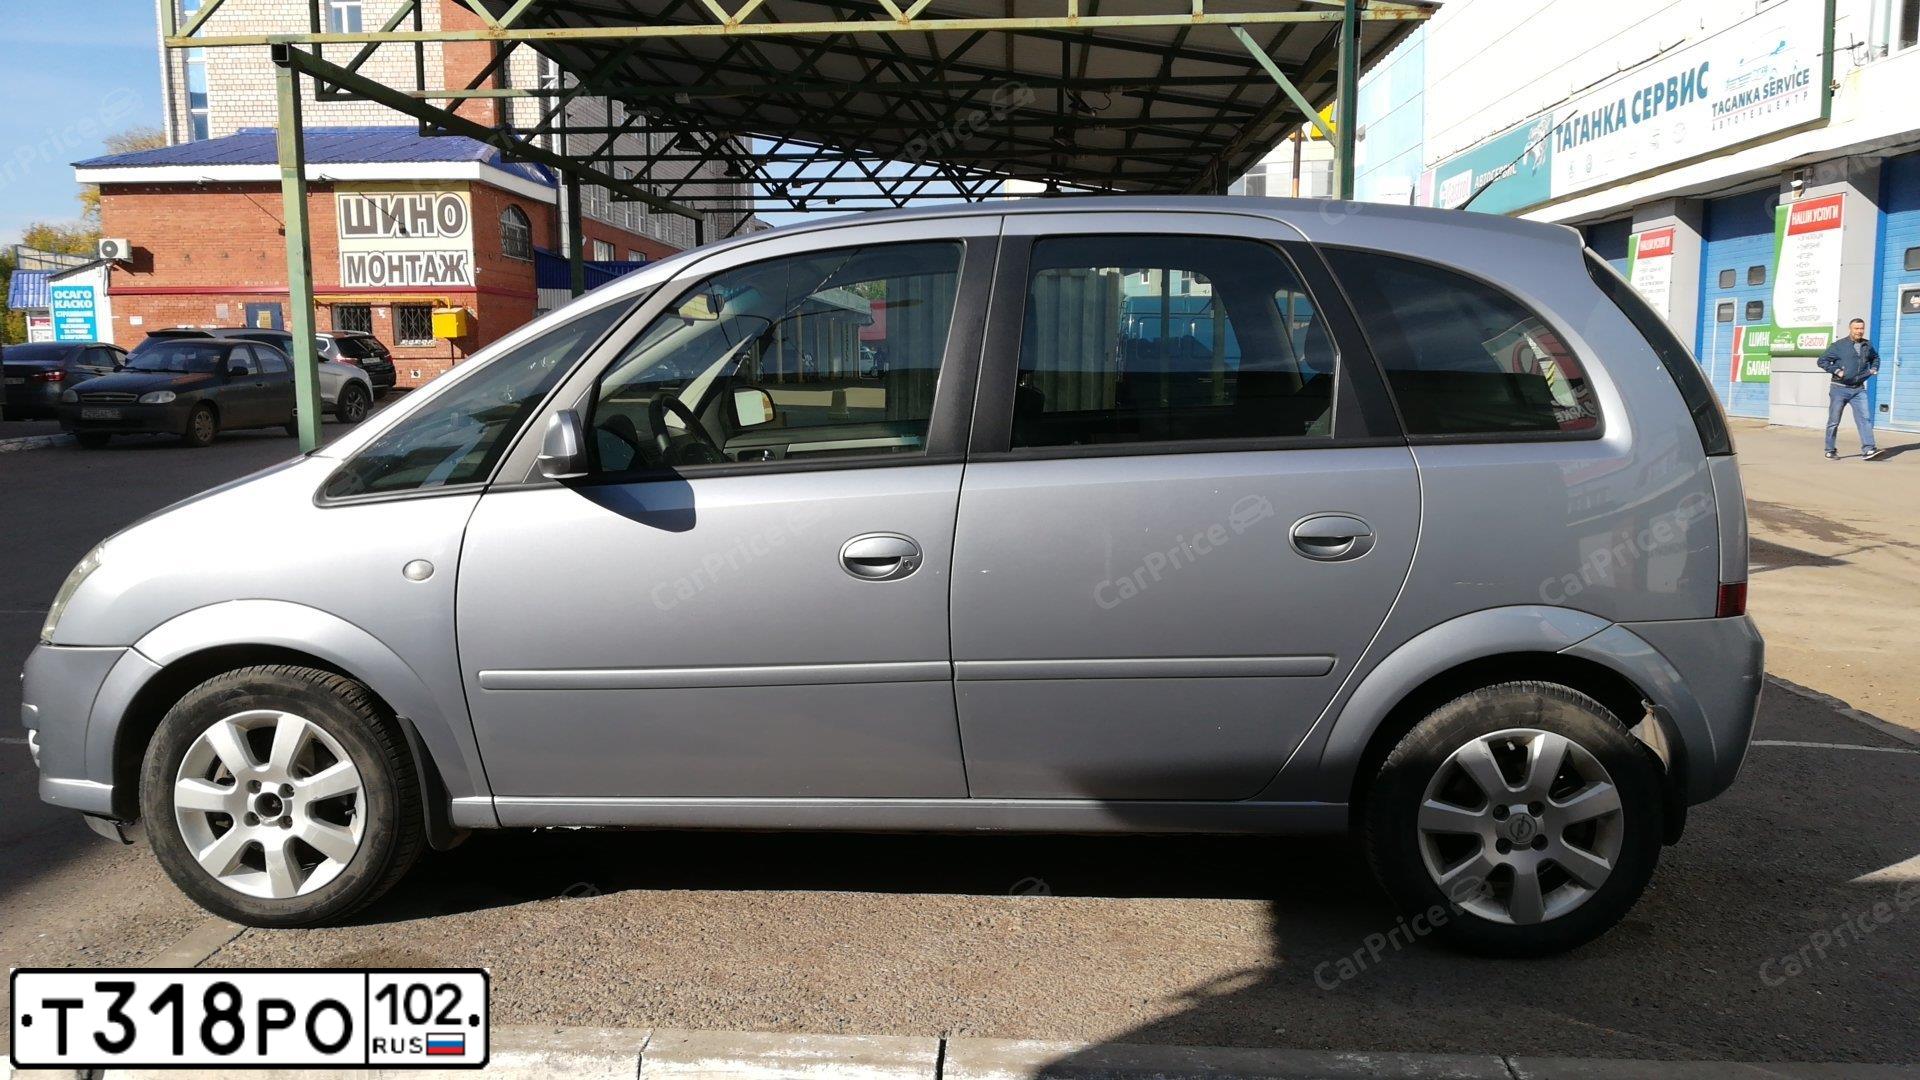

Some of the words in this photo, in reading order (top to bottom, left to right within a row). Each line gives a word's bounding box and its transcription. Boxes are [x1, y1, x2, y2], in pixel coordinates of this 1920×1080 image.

[1556, 97, 1627, 153] ТАГАНКА
[1632, 61, 1709, 124] СЕРВИС
[1712, 88, 1760, 117] TAGANKA
[1763, 68, 1810, 98] SERVICE
[341, 194, 466, 237] ШИНО
[1792, 209, 1812, 225] НАШИ
[344, 252, 467, 285] МОНТАЖ
[54, 290, 92, 299] ОСАГО
[55, 300, 93, 309] КАСКО
